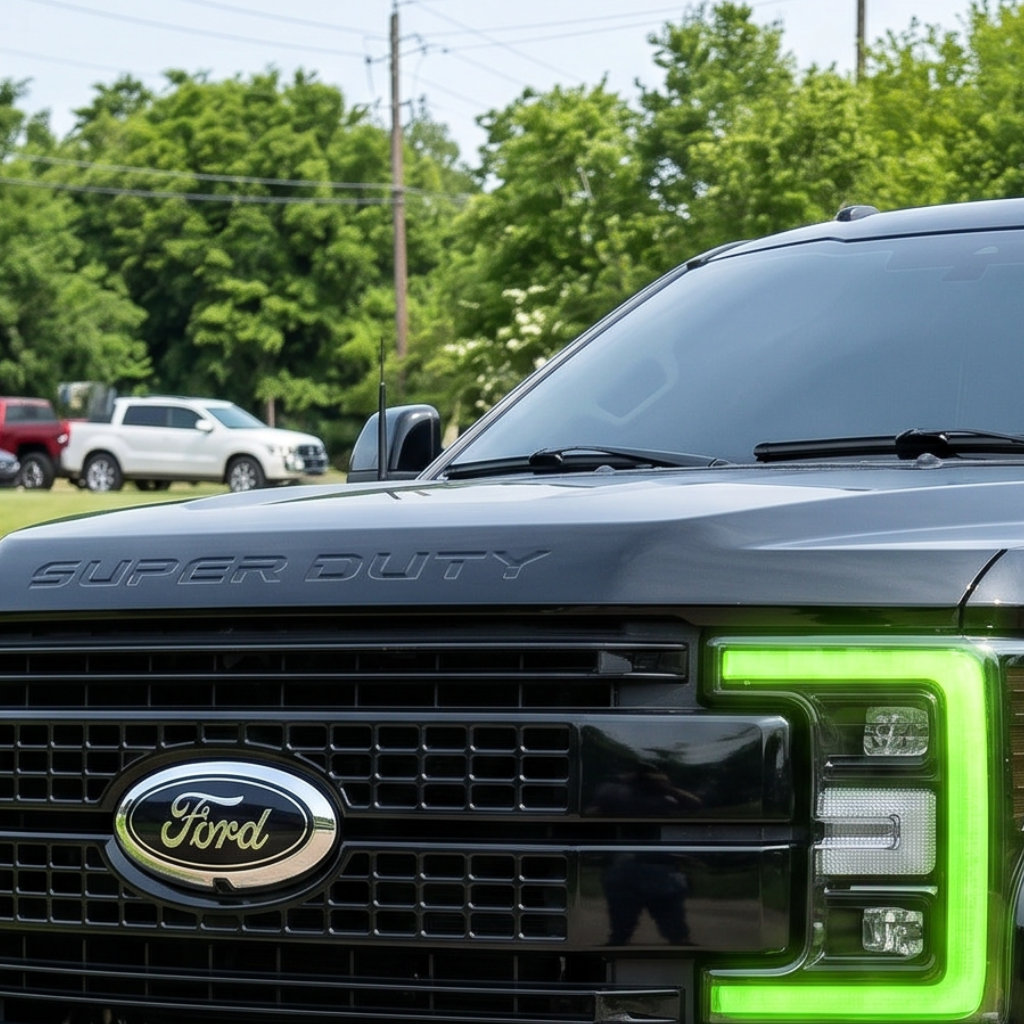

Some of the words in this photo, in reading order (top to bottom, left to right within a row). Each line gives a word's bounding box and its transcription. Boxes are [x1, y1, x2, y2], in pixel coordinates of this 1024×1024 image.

[28, 556, 288, 589] SUPER
[304, 550, 552, 583] DUTY
[160, 791, 273, 850] Ford
